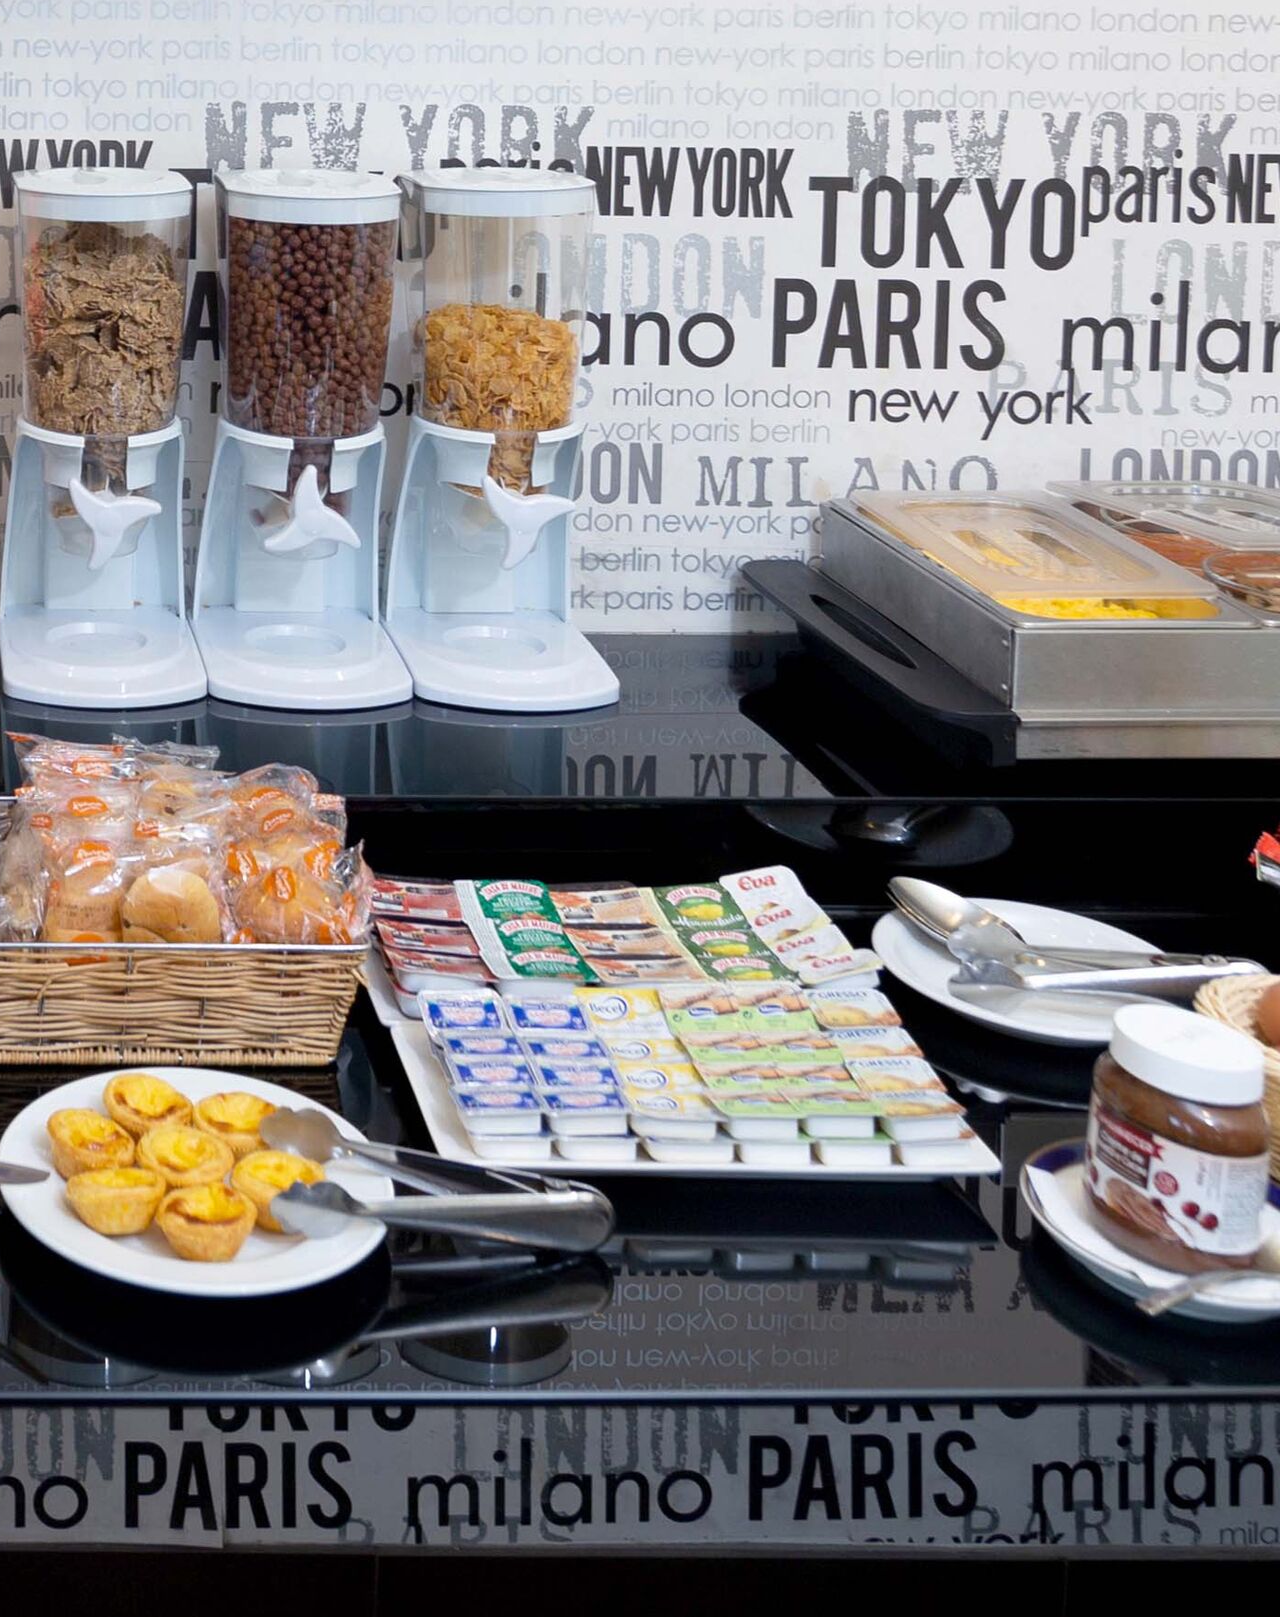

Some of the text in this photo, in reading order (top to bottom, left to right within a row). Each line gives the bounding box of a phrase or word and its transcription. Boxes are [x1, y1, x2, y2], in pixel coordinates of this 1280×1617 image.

[809, 176, 1075, 270] TOKYO
[1082, 149, 1216, 237] paris
[771, 278, 1007, 372] PARIS
[848, 369, 1093, 441] new york
[582, 548, 661, 573] berlin
[605, 587, 764, 614] paris berlin
[124, 1440, 354, 1531] PARIS
[405, 1439, 713, 1531] milano
[748, 1431, 979, 1522] PARIS
